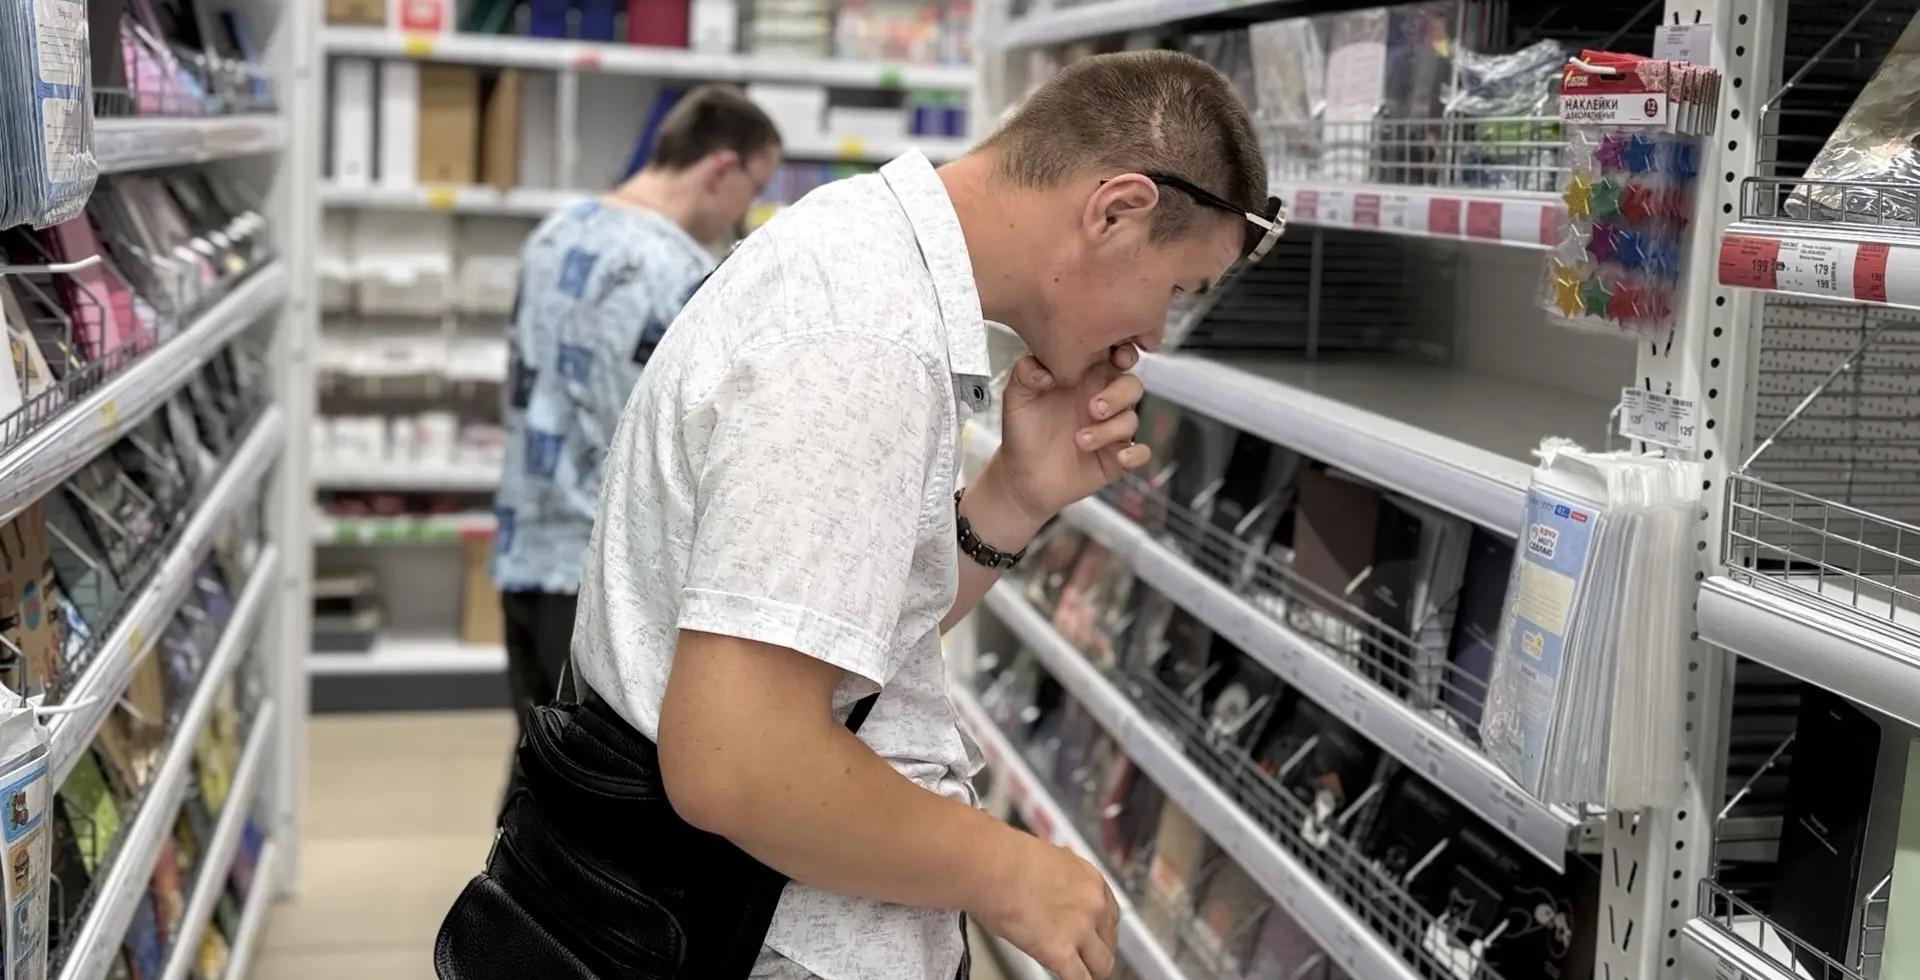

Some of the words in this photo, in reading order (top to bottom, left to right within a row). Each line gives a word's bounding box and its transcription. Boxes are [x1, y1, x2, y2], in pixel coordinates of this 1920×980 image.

[1565, 97, 1618, 111] НАКЛЕЙКИ
[1647, 101, 1657, 110] 12
[1752, 259, 1768, 273] 199
[1814, 264, 1829, 275] 179
